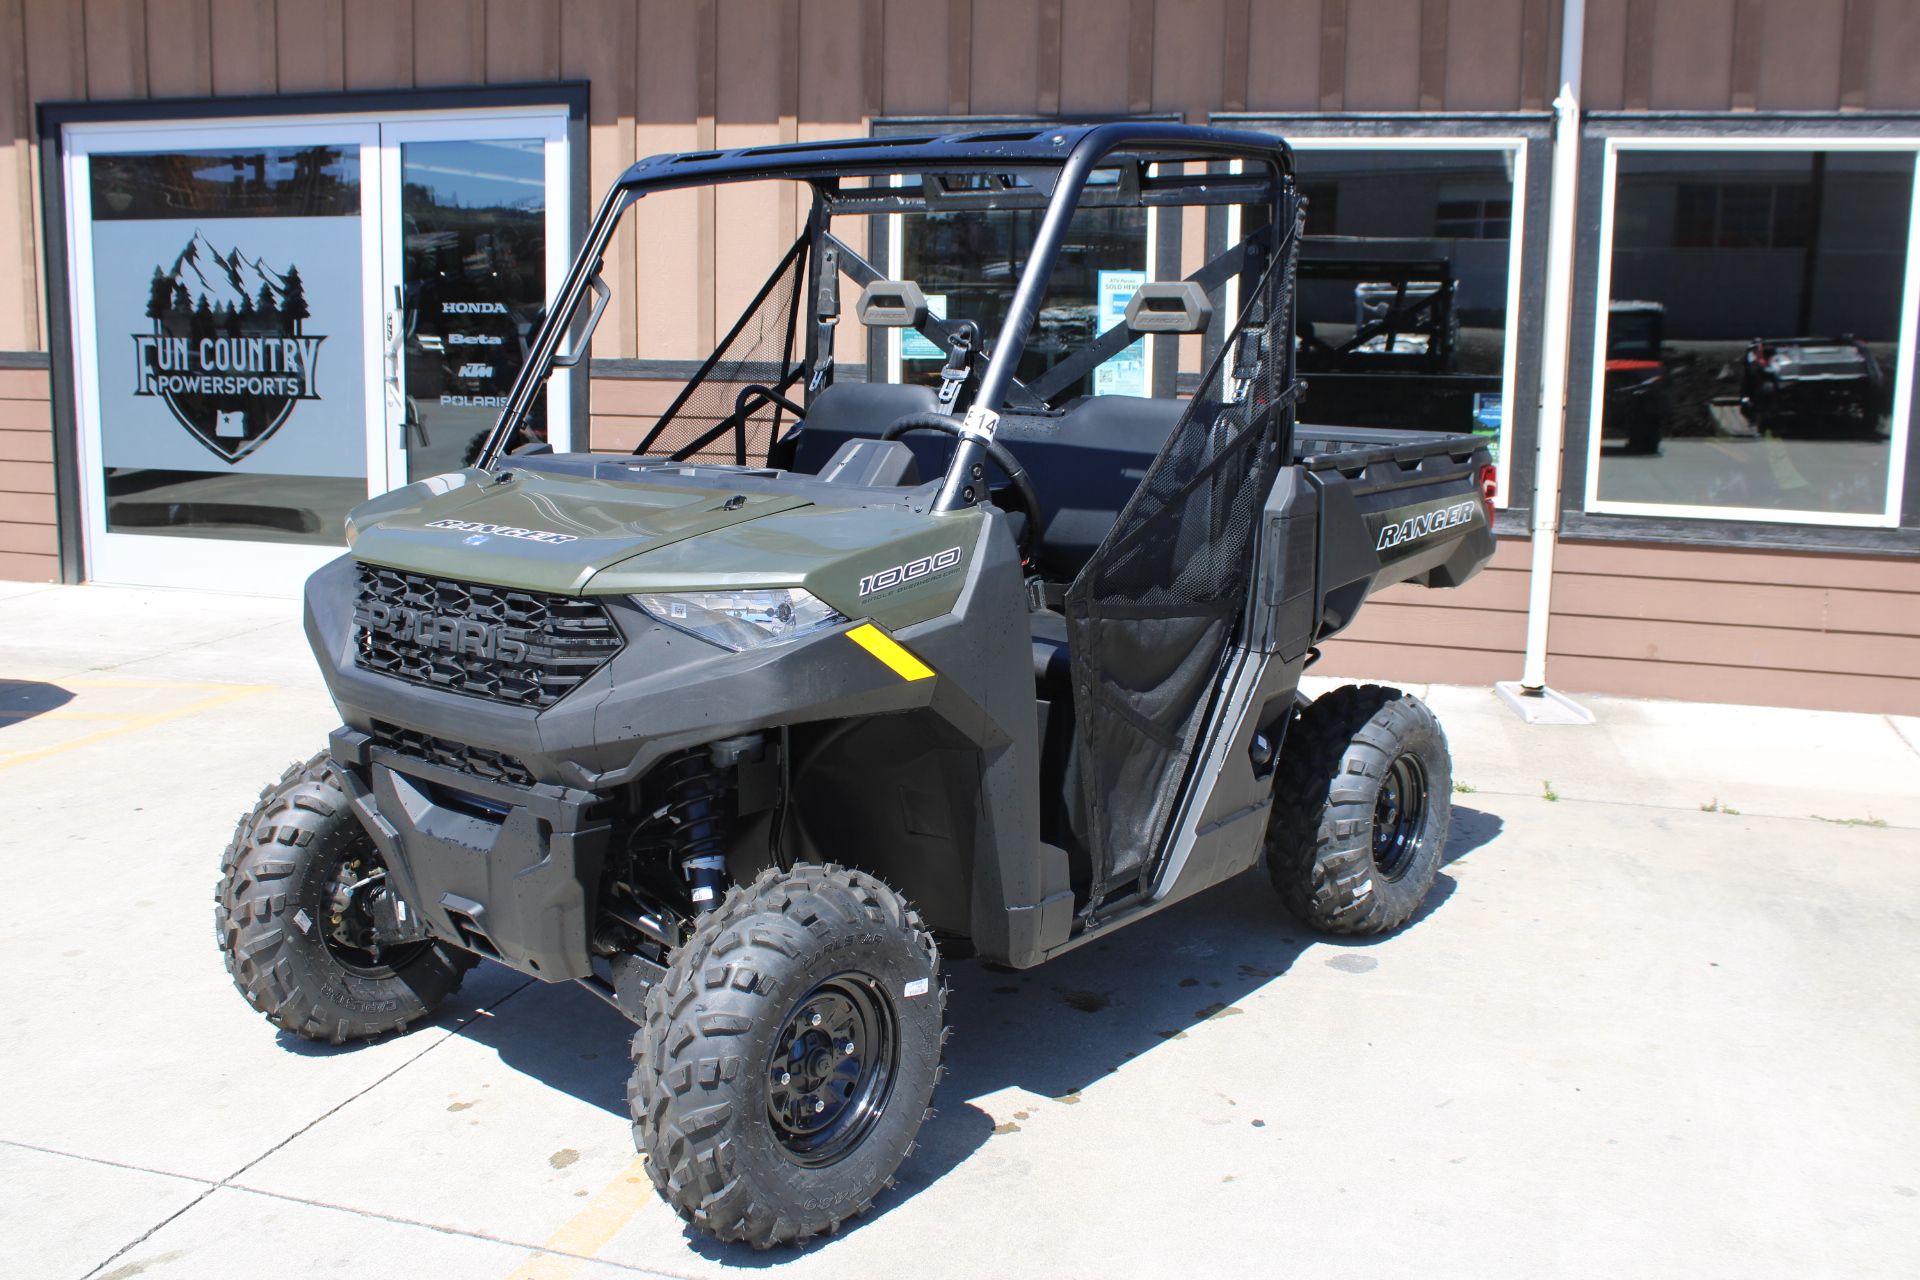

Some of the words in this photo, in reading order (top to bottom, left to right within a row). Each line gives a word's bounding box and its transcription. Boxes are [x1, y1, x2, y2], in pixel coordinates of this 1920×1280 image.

[442, 302, 508, 314] HONDA
[448, 333, 502, 345] Beta
[136, 336, 189, 394] FUN
[200, 336, 319, 397] COUNTRY
[458, 363, 493, 378] KTM
[158, 375, 299, 396] POWERSPORTS
[440, 395, 508, 408] POLARIS
[425, 519, 578, 545] RANGER
[1376, 500, 1475, 551] RANGER
[859, 546, 962, 596] 1000
[367, 600, 529, 664] POLARIS
